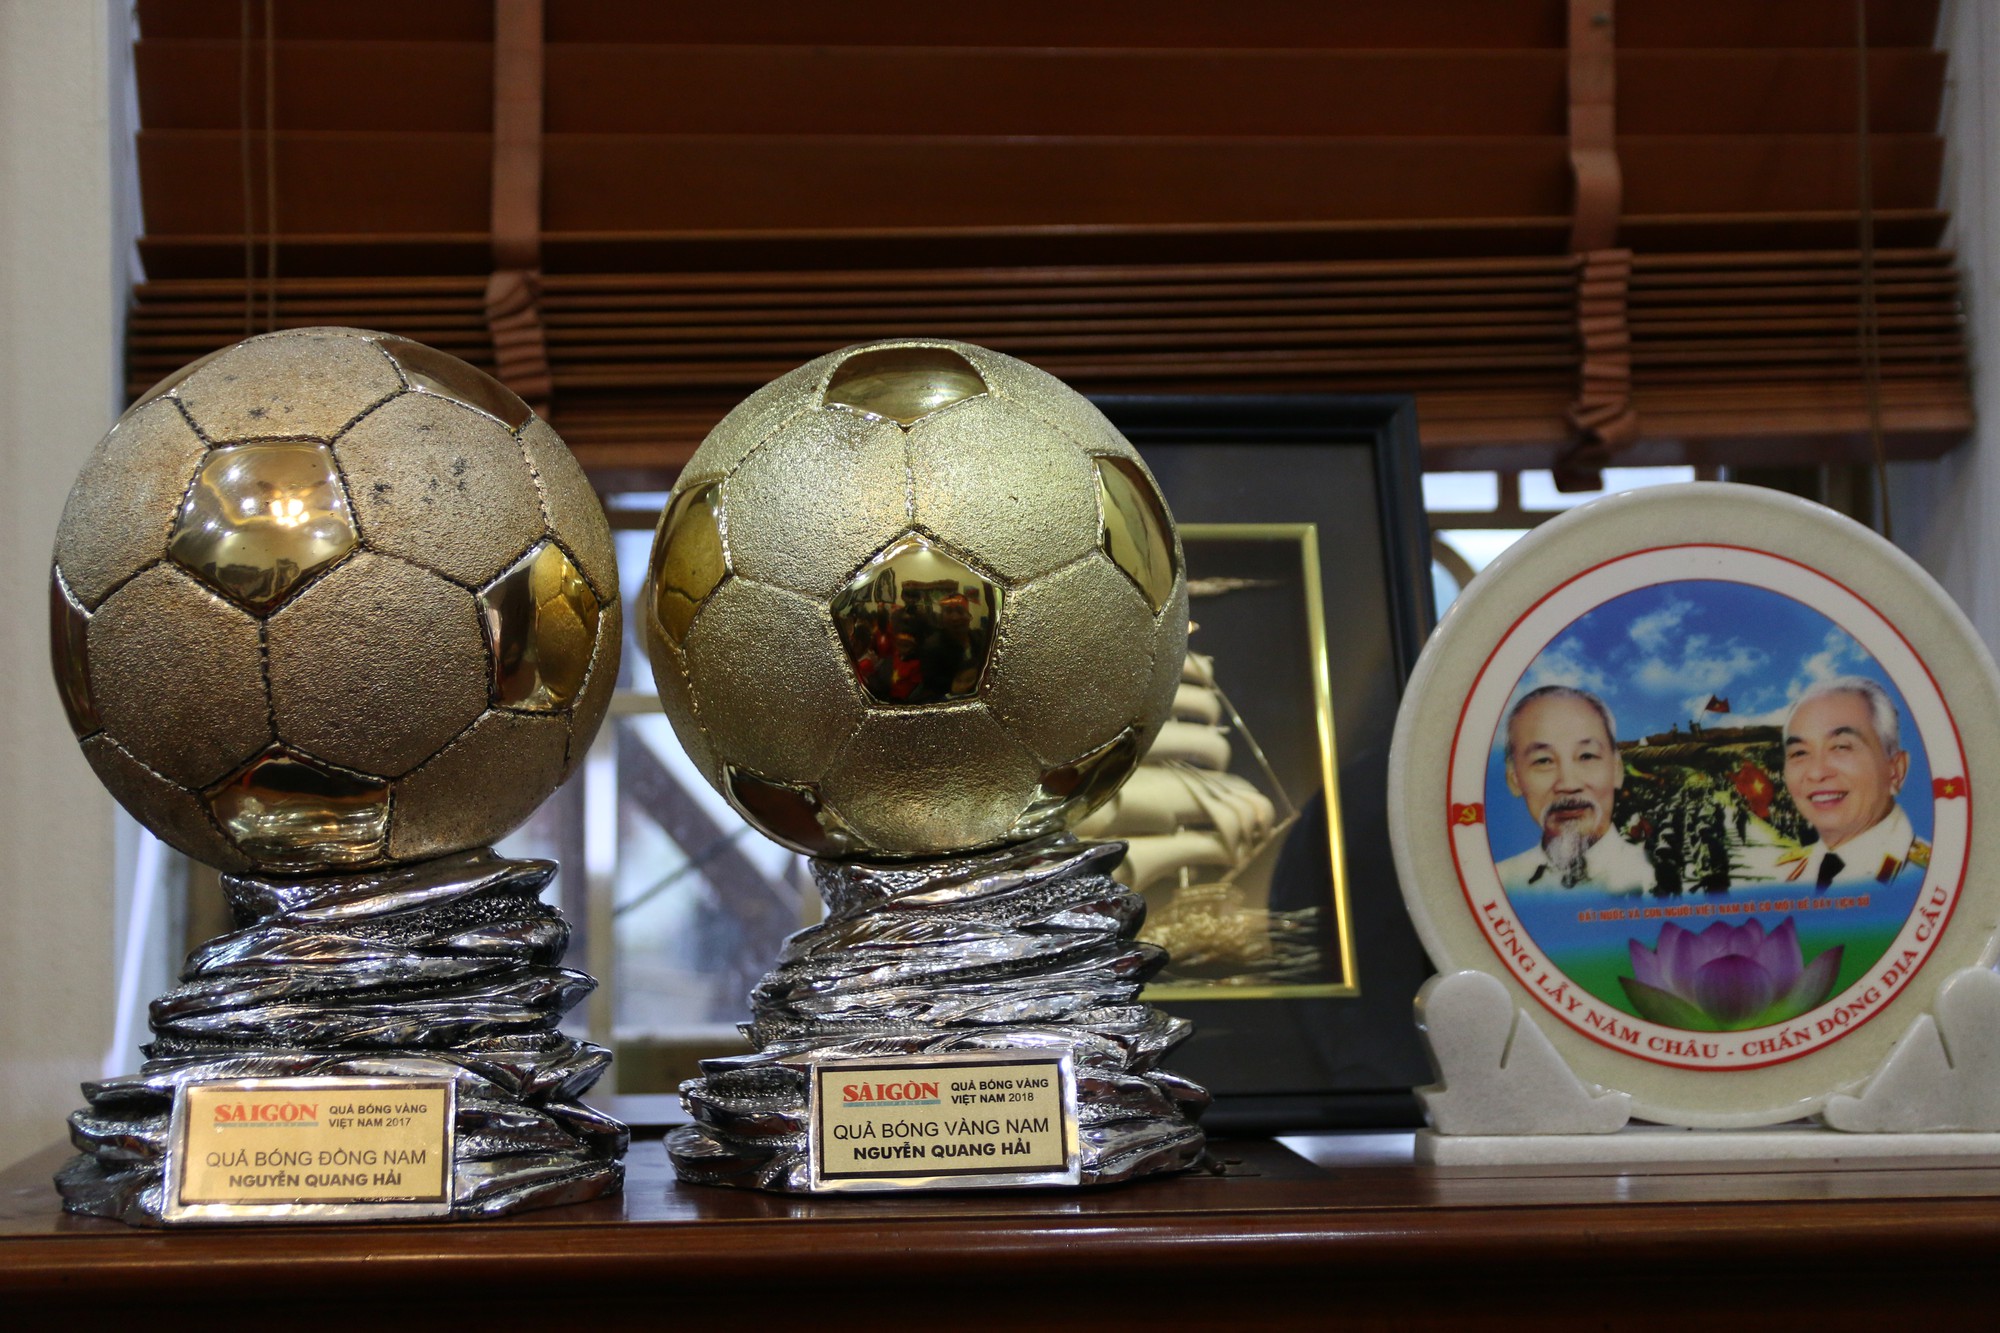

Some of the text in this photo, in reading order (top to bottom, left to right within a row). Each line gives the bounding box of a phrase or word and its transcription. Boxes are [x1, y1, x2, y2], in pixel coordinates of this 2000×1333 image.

[1585, 1010, 1641, 1045] NĂM
[1648, 1036, 1719, 1058] CHÂU
[1741, 1027, 1812, 1057] CHẤN
[1816, 987, 1882, 1036] ĐỘNG
[1881, 949, 1919, 989] ĐỊA
[980, 1079, 1013, 1090] BÓNG
[1016, 1078, 1049, 1089] VÀNG
[358, 1102, 391, 1114] BÓNG
[394, 1101, 427, 1113] VÀNG
[951, 1093, 976, 1106] VIỆT
[980, 1095, 1006, 1103] NAM
[1009, 1093, 1034, 1102] 2018
[329, 1116, 354, 1129] VIỆT
[358, 1118, 383, 1127] NAM
[386, 1117, 411, 1127] 2017
[833, 1118, 1049, 1141] QUẢ BÓNG VÀNG NAM
[206, 1148, 249, 1168] QUẢ
[255, 1148, 312, 1167] BÓNG
[384, 1150, 426, 1164] NAM
[853, 1138, 1030, 1160] NGUYỄN QUANG HẢI
[229, 1168, 401, 1188] NGUYỄN QUANG HẢI
